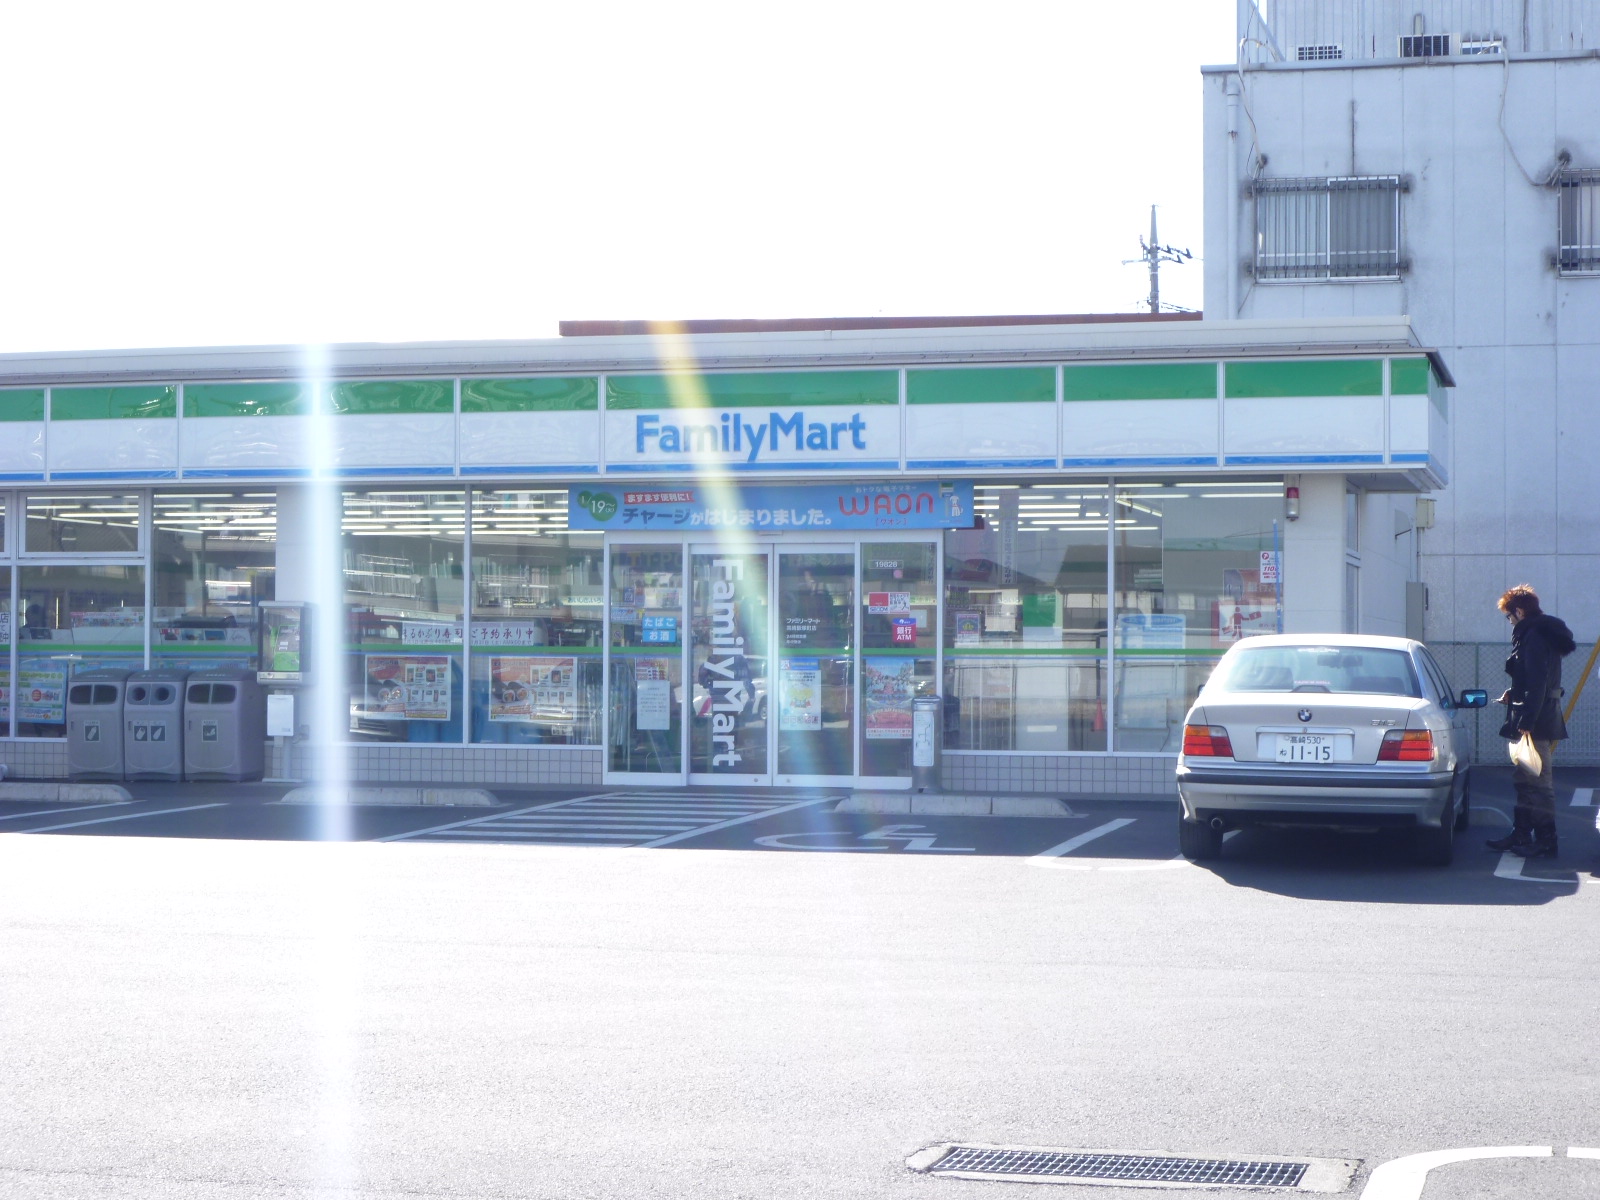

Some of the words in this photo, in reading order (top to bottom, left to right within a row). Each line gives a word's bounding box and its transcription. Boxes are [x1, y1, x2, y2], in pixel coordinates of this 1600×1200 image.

[636, 411, 866, 463] FamilyMart
[838, 492, 934, 517] WAON
[643, 617, 675, 627] たばこ
[896, 626, 912, 634] 銀行
[648, 630, 671, 641] お酒
[704, 559, 746, 768] FamilyMart
[1279, 747, 1287, 757] ね
[1290, 745, 1331, 761] 11-15
